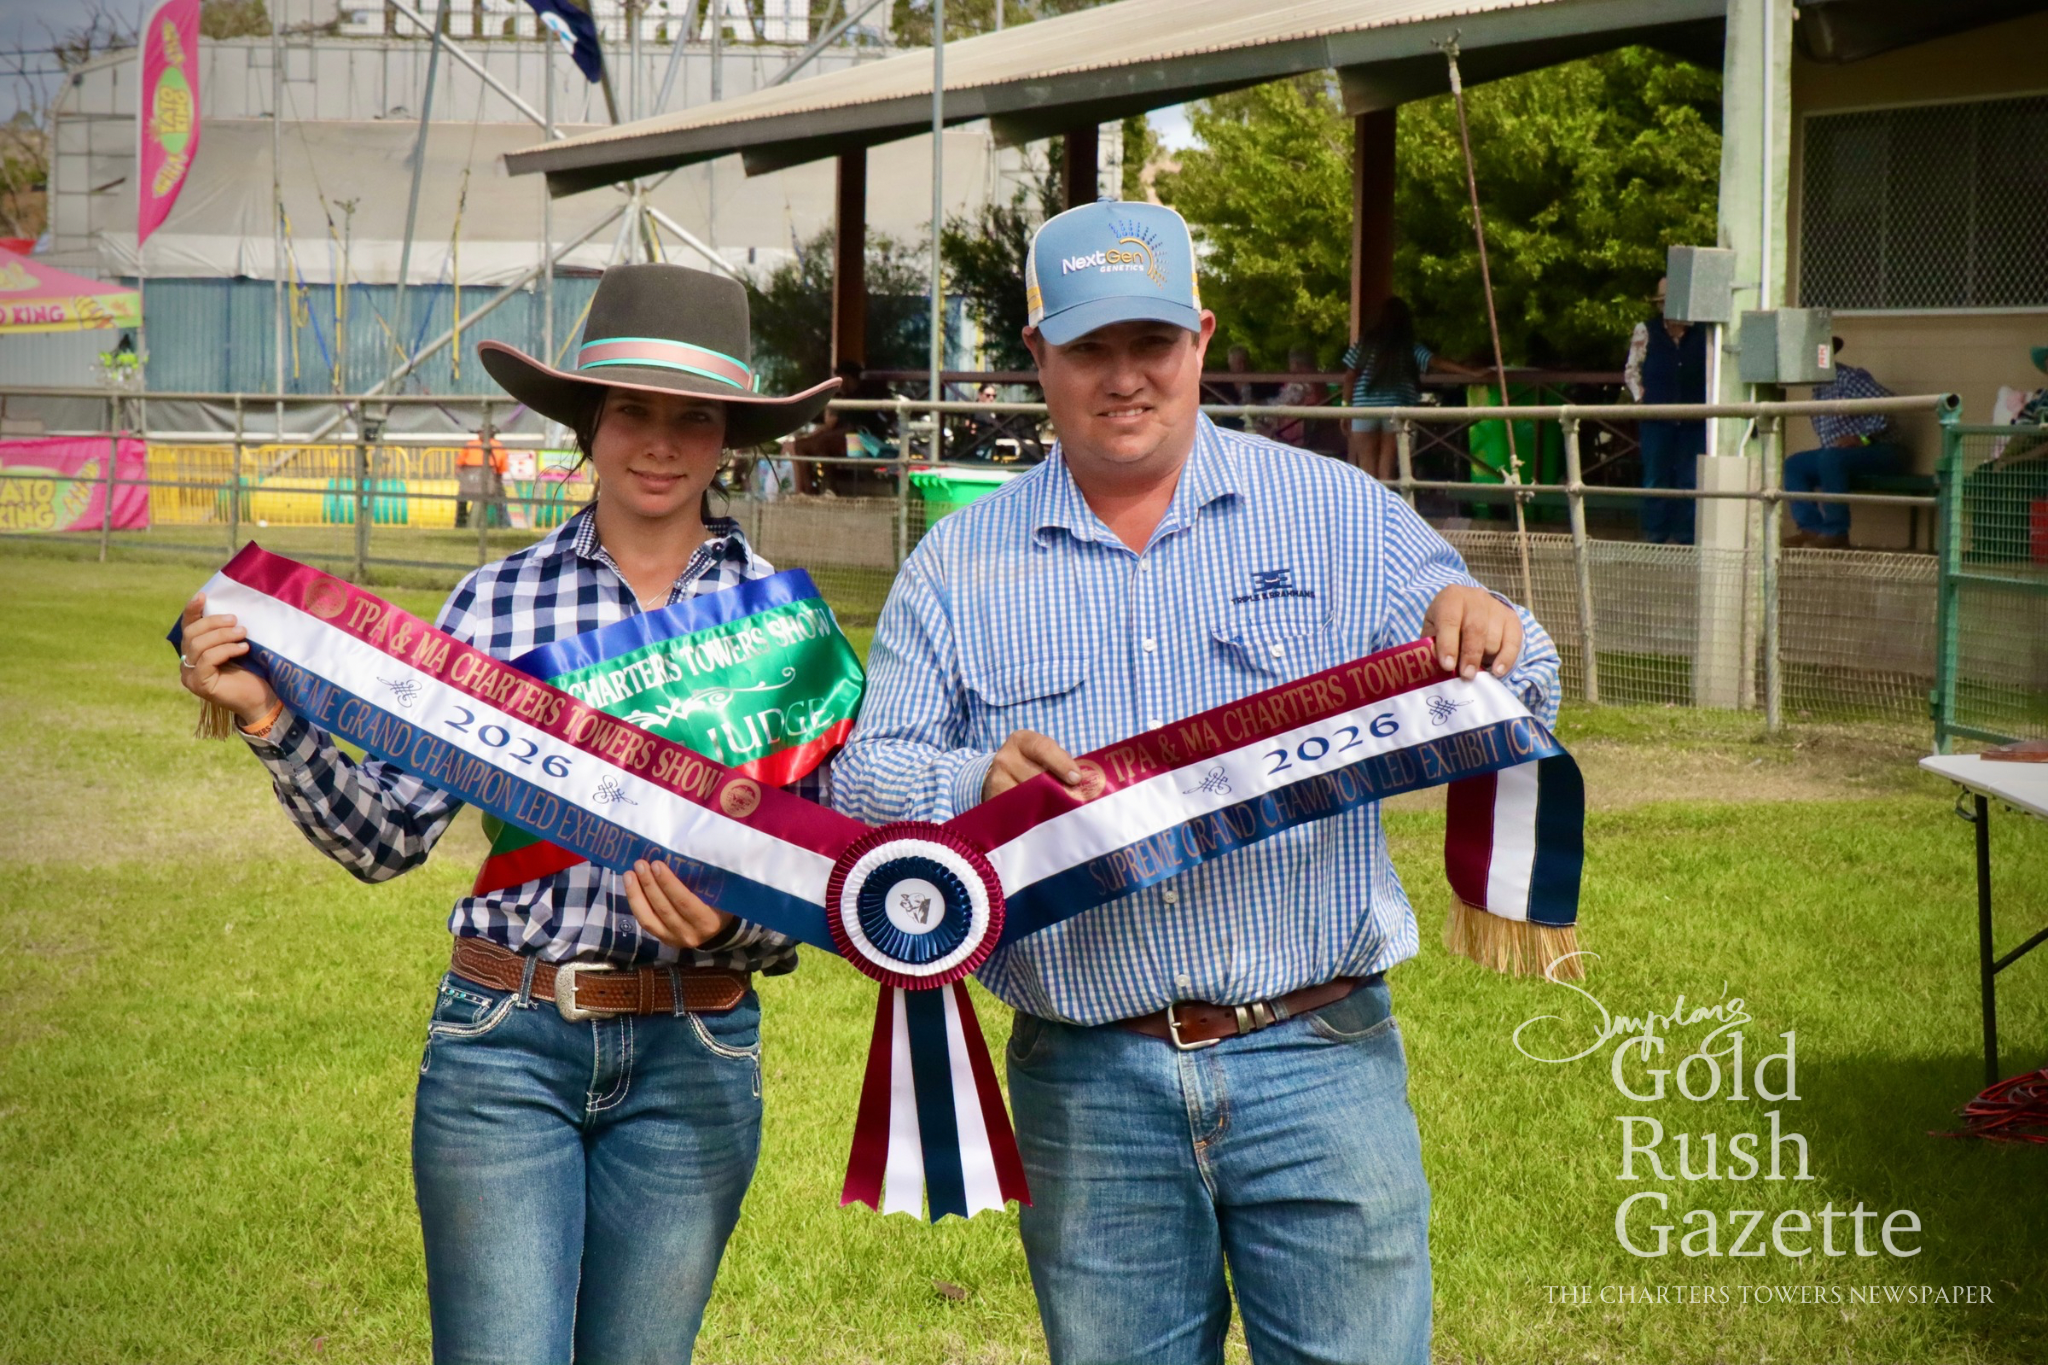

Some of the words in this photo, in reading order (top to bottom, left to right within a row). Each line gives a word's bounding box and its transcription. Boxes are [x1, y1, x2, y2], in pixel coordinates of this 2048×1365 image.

[1062, 249, 1144, 275] NextGen
[1100, 264, 1145, 273] GENETICS
[12, 305, 65, 325] KING
[568, 653, 684, 709] CHARTERS
[681, 628, 770, 677] TOWERS
[766, 607, 832, 648] SHOW
[347, 597, 389, 643] TPA
[391, 622, 413, 655] &
[413, 632, 451, 673] MA
[450, 653, 567, 726] CHARTERS
[562, 705, 658, 770] TOWERS
[652, 748, 726, 801] SHOW
[706, 697, 835, 766] JUDGE
[1104, 741, 1158, 784] TPA
[1158, 734, 1183, 764] &
[1178, 719, 1222, 757] MA
[1222, 674, 1348, 743] CHARTERS
[1347, 645, 1437, 700] TOWER
[444, 705, 573, 778] 2026
[1262, 712, 1400, 777] 2026
[338, 699, 412, 757] GRAND
[410, 735, 521, 813] CHAMPION
[515, 795, 560, 831] LED
[556, 807, 639, 867] EXHIBIT
[1089, 831, 1183, 896] SUPREME
[1181, 803, 1256, 859] GRAND
[1259, 760, 1374, 829] CHAMPION
[1378, 749, 1417, 790] LED
[1419, 725, 1500, 780] EXHIBIT
